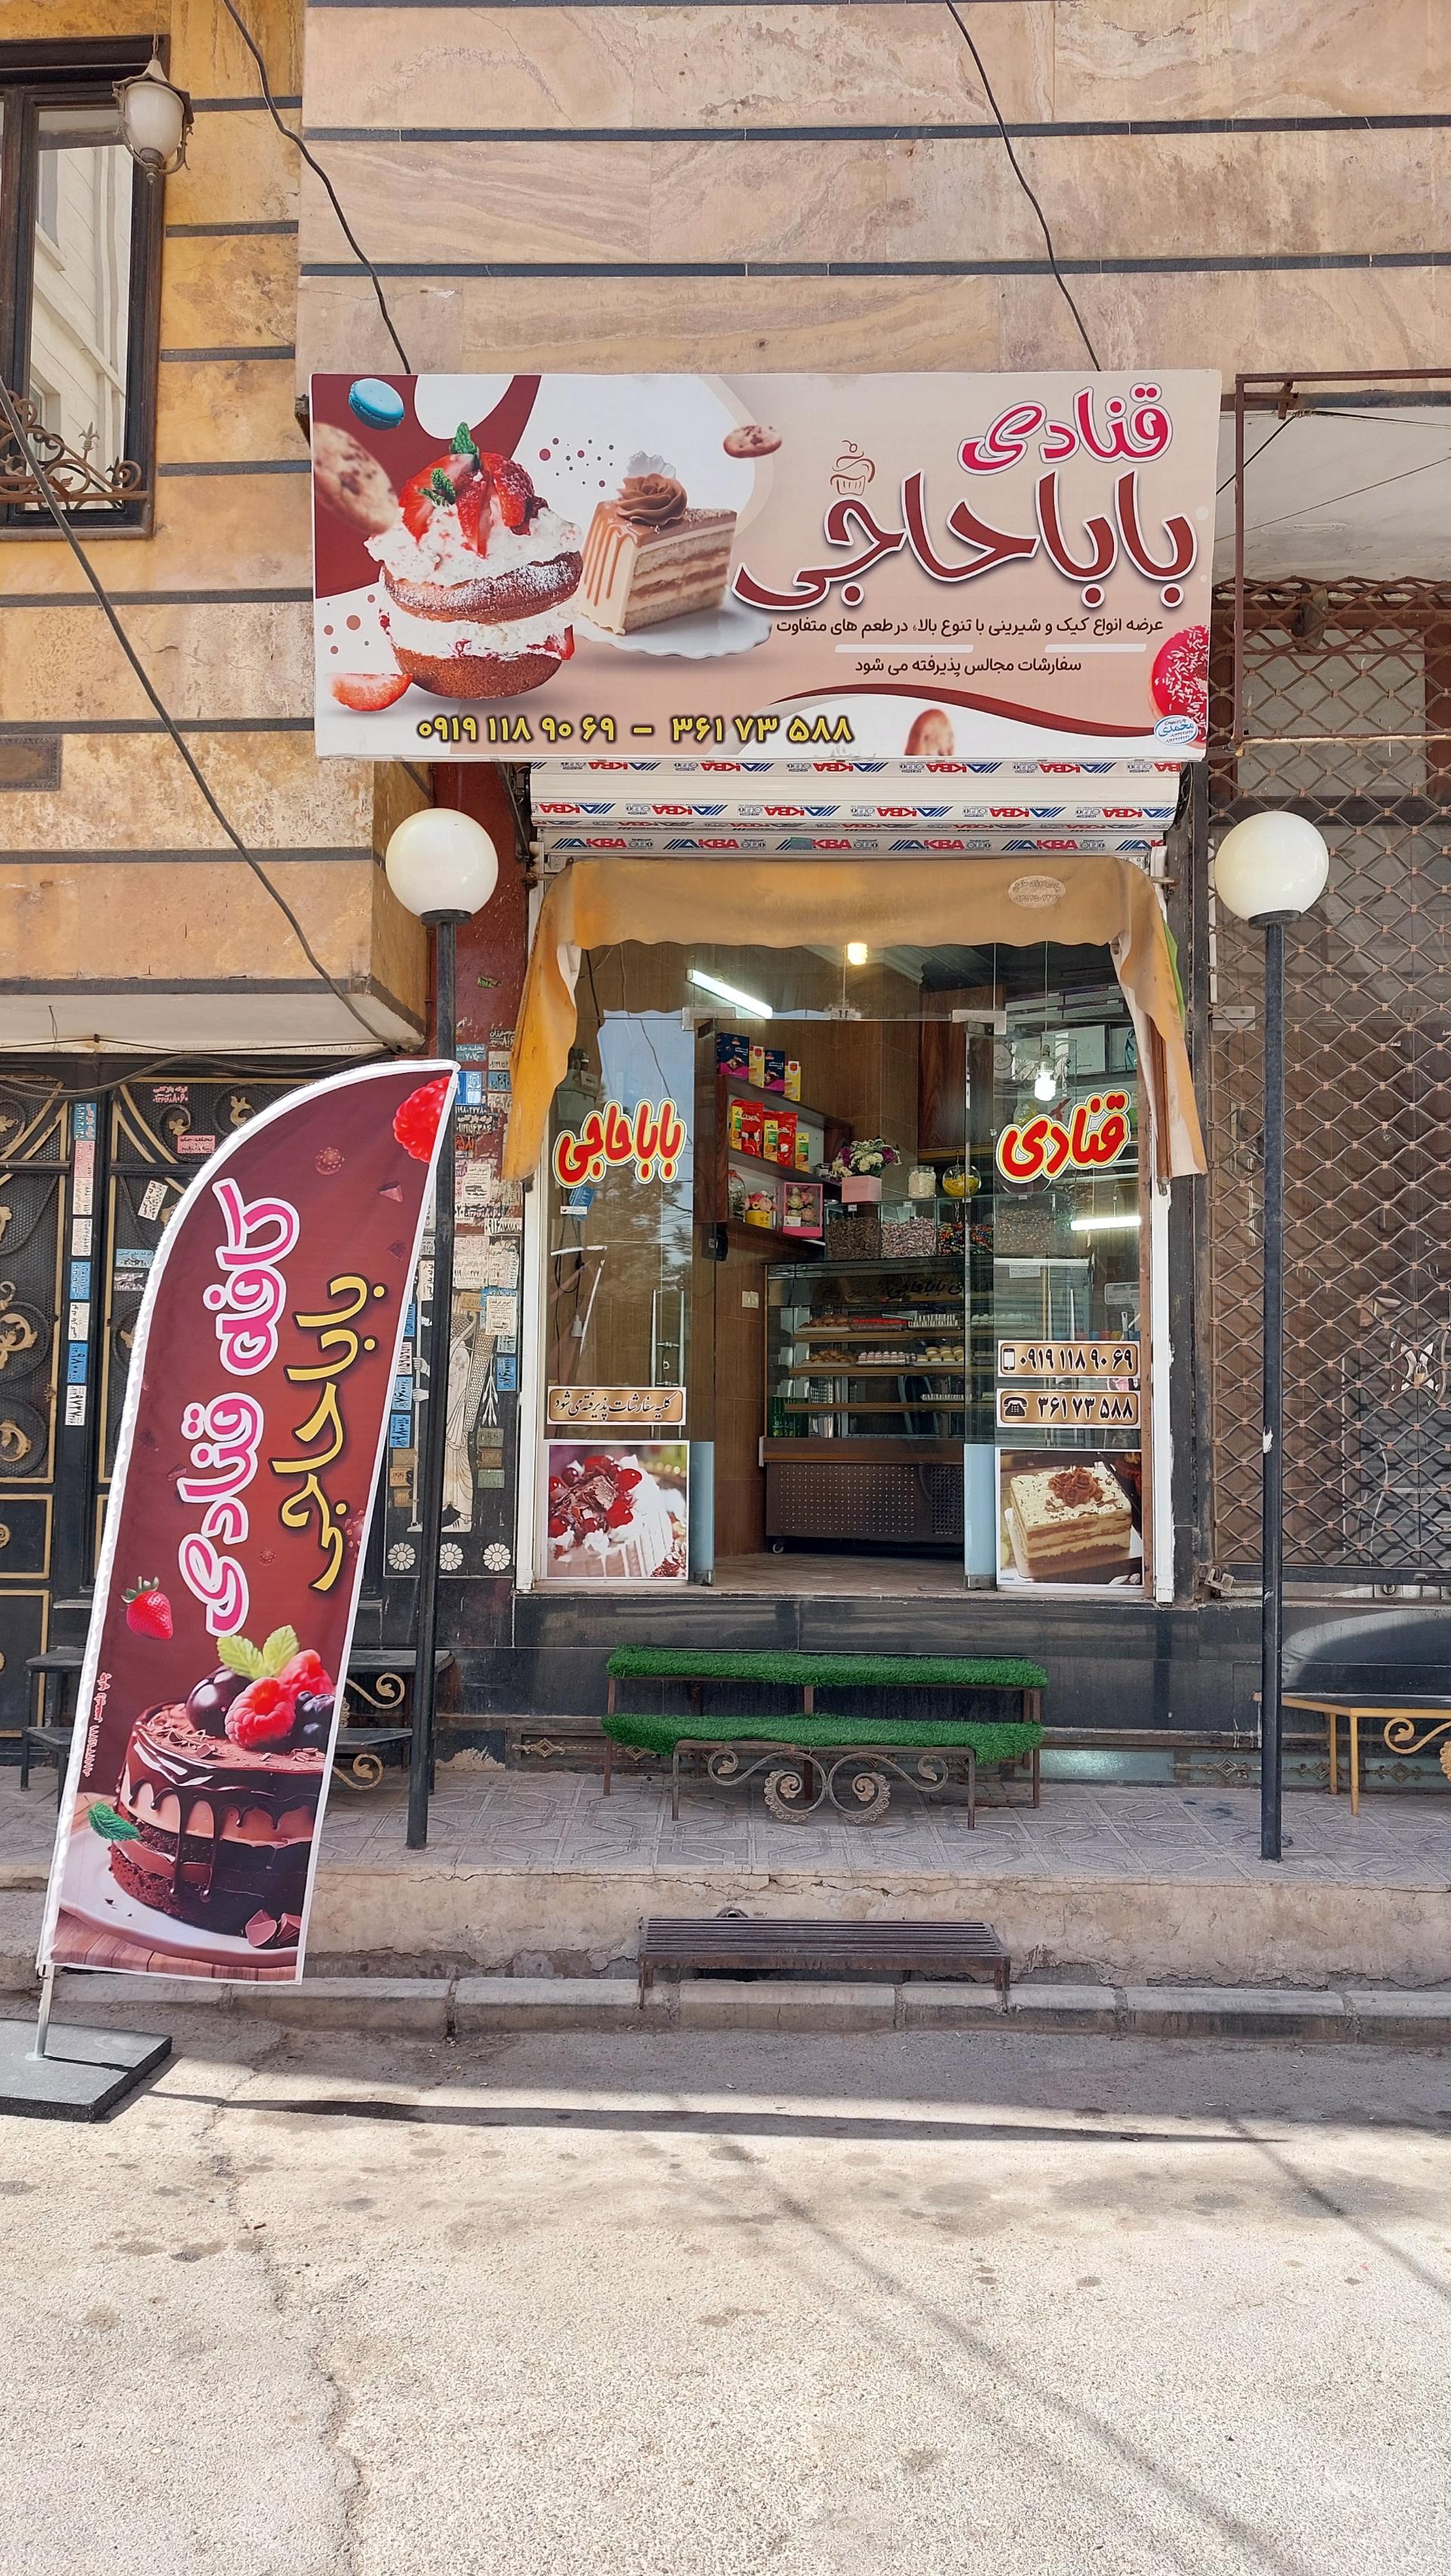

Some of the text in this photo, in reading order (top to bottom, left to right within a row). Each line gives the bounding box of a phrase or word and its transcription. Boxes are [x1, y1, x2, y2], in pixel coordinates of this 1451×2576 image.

[959, 384, 1171, 474] قنادی
[776, 617, 827, 635] متفاوت
[831, 618, 858, 635] های
[941, 618, 972, 637] تنوع
[976, 618, 985, 635] با
[988, 618, 1041, 636] شیرینی
[1045, 622, 1053, 635] و
[1057, 617, 1090, 635] کیک
[1094, 618, 1122, 636] انواع
[1126, 617, 1164, 635] عرضه
[855, 654, 1081, 677] سفارشات مجالس پذیرفته می شود
[418, 715, 477, 741] ۰۹۱۹
[488, 715, 532, 741] ۱۱۸
[672, 716, 723, 742] ۳۶۱
[787, 716, 853, 742] ۵۸۸
[996, 1090, 1131, 1183] قنادی
[1019, 1348, 1054, 1370] ۰۹۱۹
[1060, 1348, 1086, 1370] ۱۱۸
[178, 1177, 300, 1637] کافه قنادی
[555, 1391, 679, 1421] کلیه سفارشات پذیرفته می شود
[1038, 1396, 1134, 1420] ۳۶۱ ۷۳ ۵۸۸
